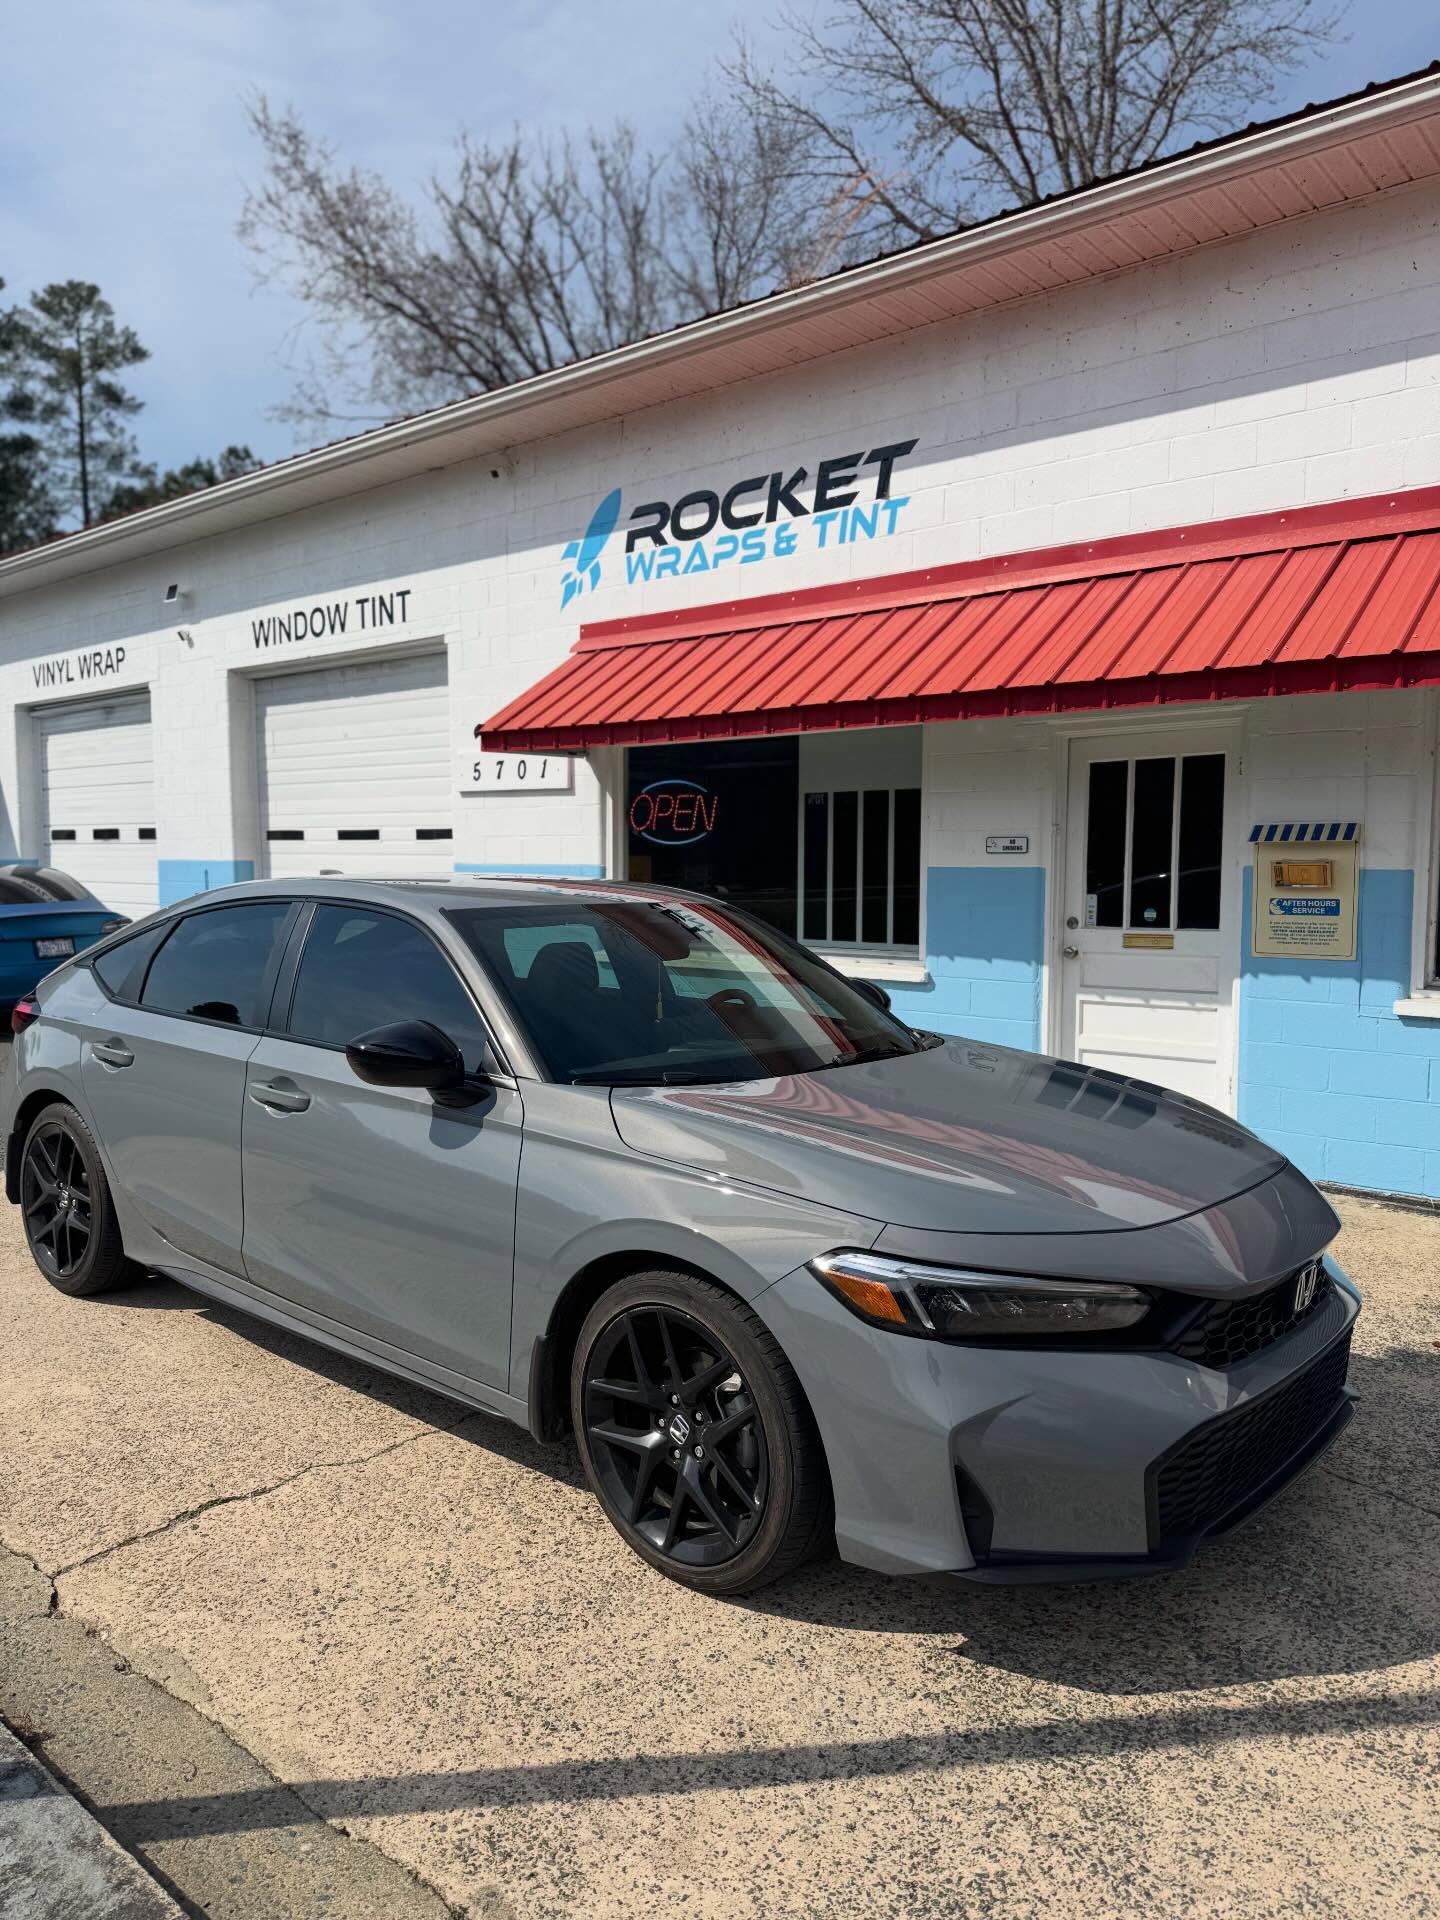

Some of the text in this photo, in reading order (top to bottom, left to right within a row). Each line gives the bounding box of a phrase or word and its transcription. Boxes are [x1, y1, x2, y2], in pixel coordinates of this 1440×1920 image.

[626, 438, 920, 553] ROCKET
[625, 496, 911, 584] WRAPS & TINT
[252, 590, 412, 648] WINDOW TINT
[32, 647, 126, 688] VINYL WRAP
[629, 793, 718, 831] OPEN
